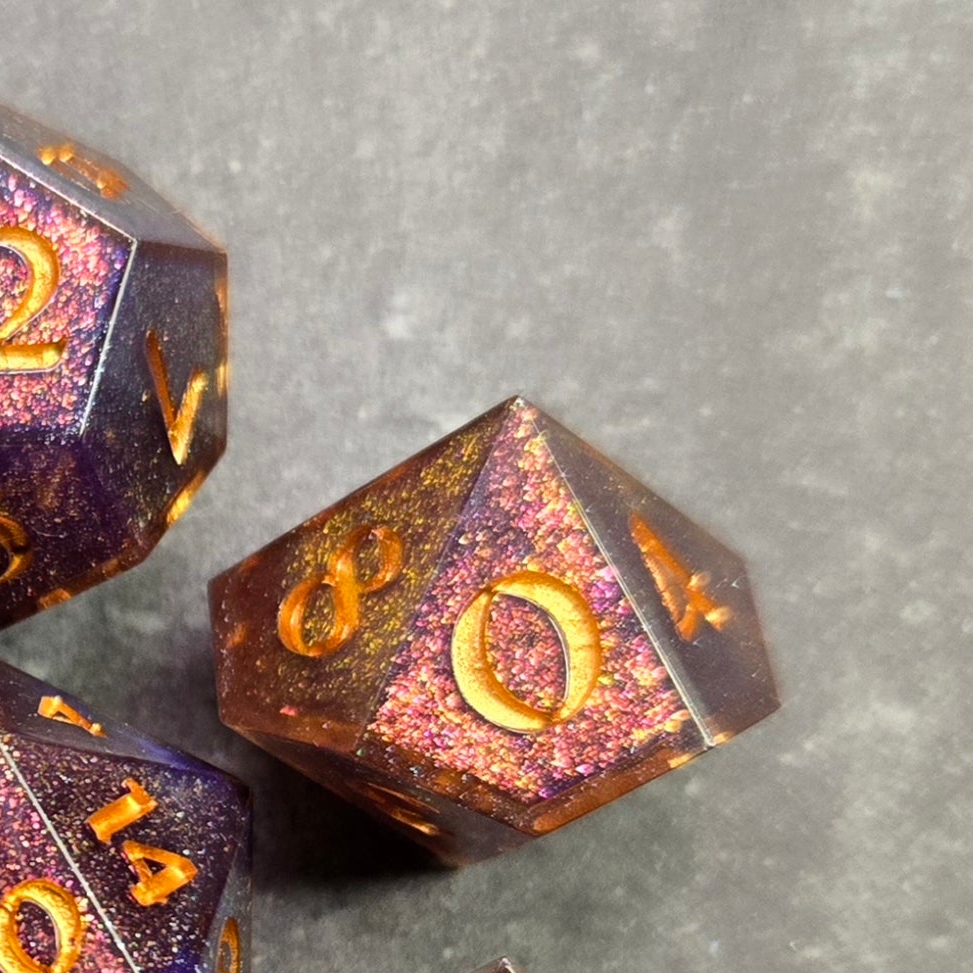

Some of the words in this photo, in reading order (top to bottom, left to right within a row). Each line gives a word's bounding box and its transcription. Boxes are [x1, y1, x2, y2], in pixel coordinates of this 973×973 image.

[278, 525, 404, 658] 8
[629, 510, 731, 643] 4
[451, 569, 602, 733] 0
[87, 777, 198, 907] 14
